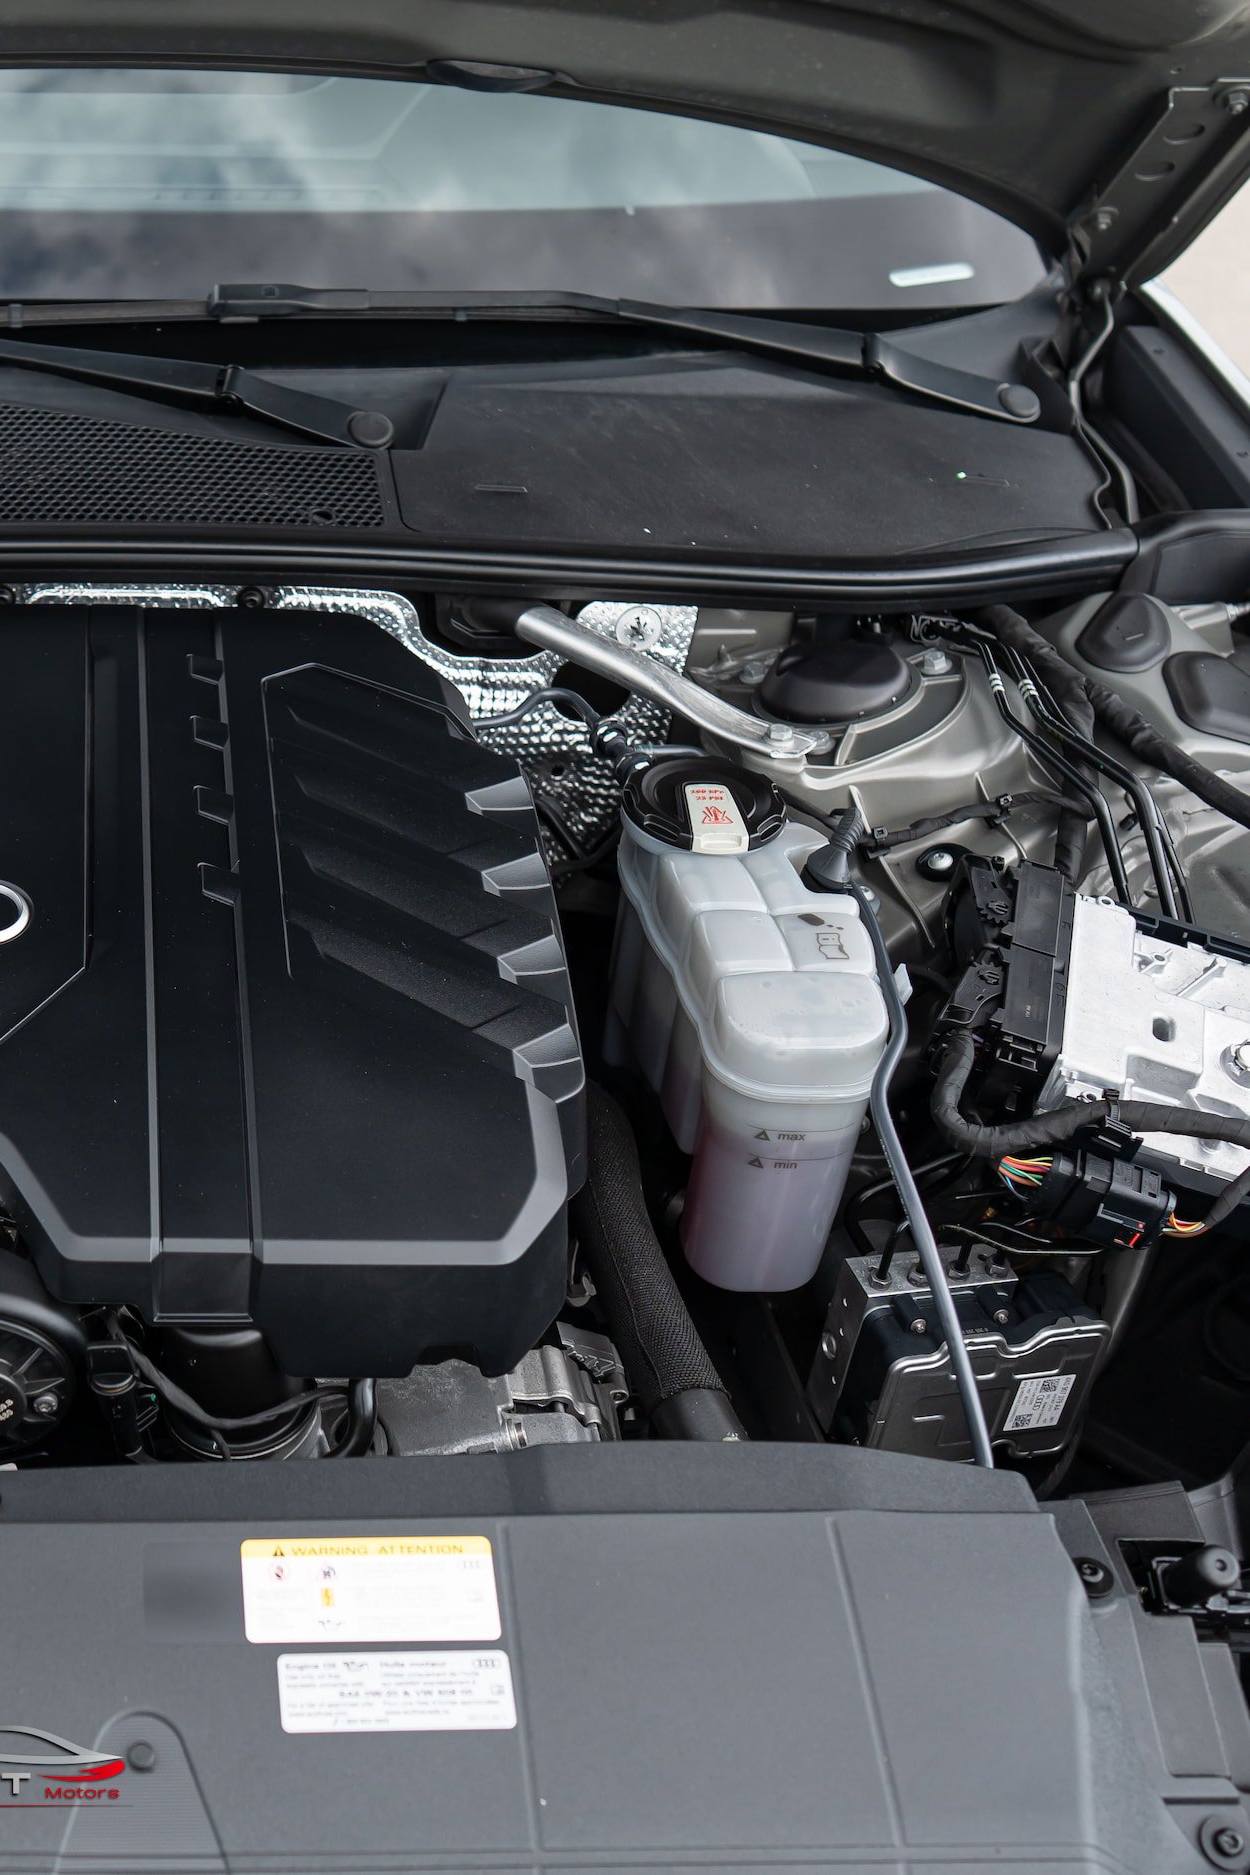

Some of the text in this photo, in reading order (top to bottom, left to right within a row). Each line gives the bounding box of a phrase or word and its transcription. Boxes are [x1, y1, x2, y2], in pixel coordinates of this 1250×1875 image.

[777, 1133, 806, 1141] max
[774, 1161, 798, 1169] min
[291, 1544, 464, 1556] WARNING ATTENTION
